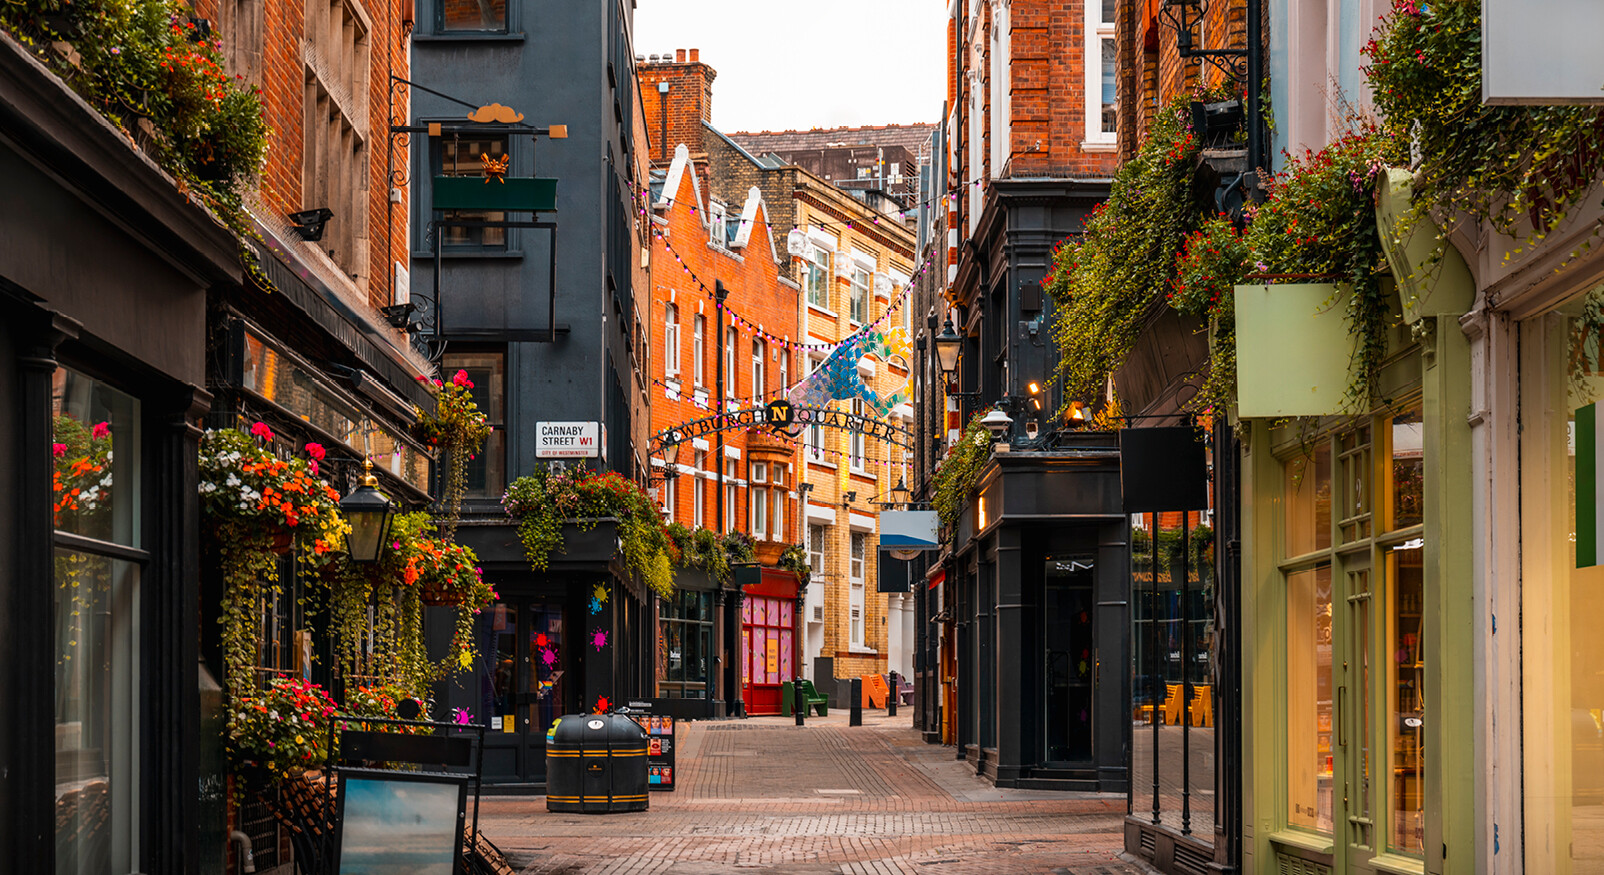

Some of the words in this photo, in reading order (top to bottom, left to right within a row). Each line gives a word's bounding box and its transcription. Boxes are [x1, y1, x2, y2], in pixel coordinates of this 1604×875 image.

[798, 408, 895, 441] QUARTER
[541, 426, 584, 436] CARNABY
[542, 437, 575, 446] STREET
[579, 437, 593, 446] W1
